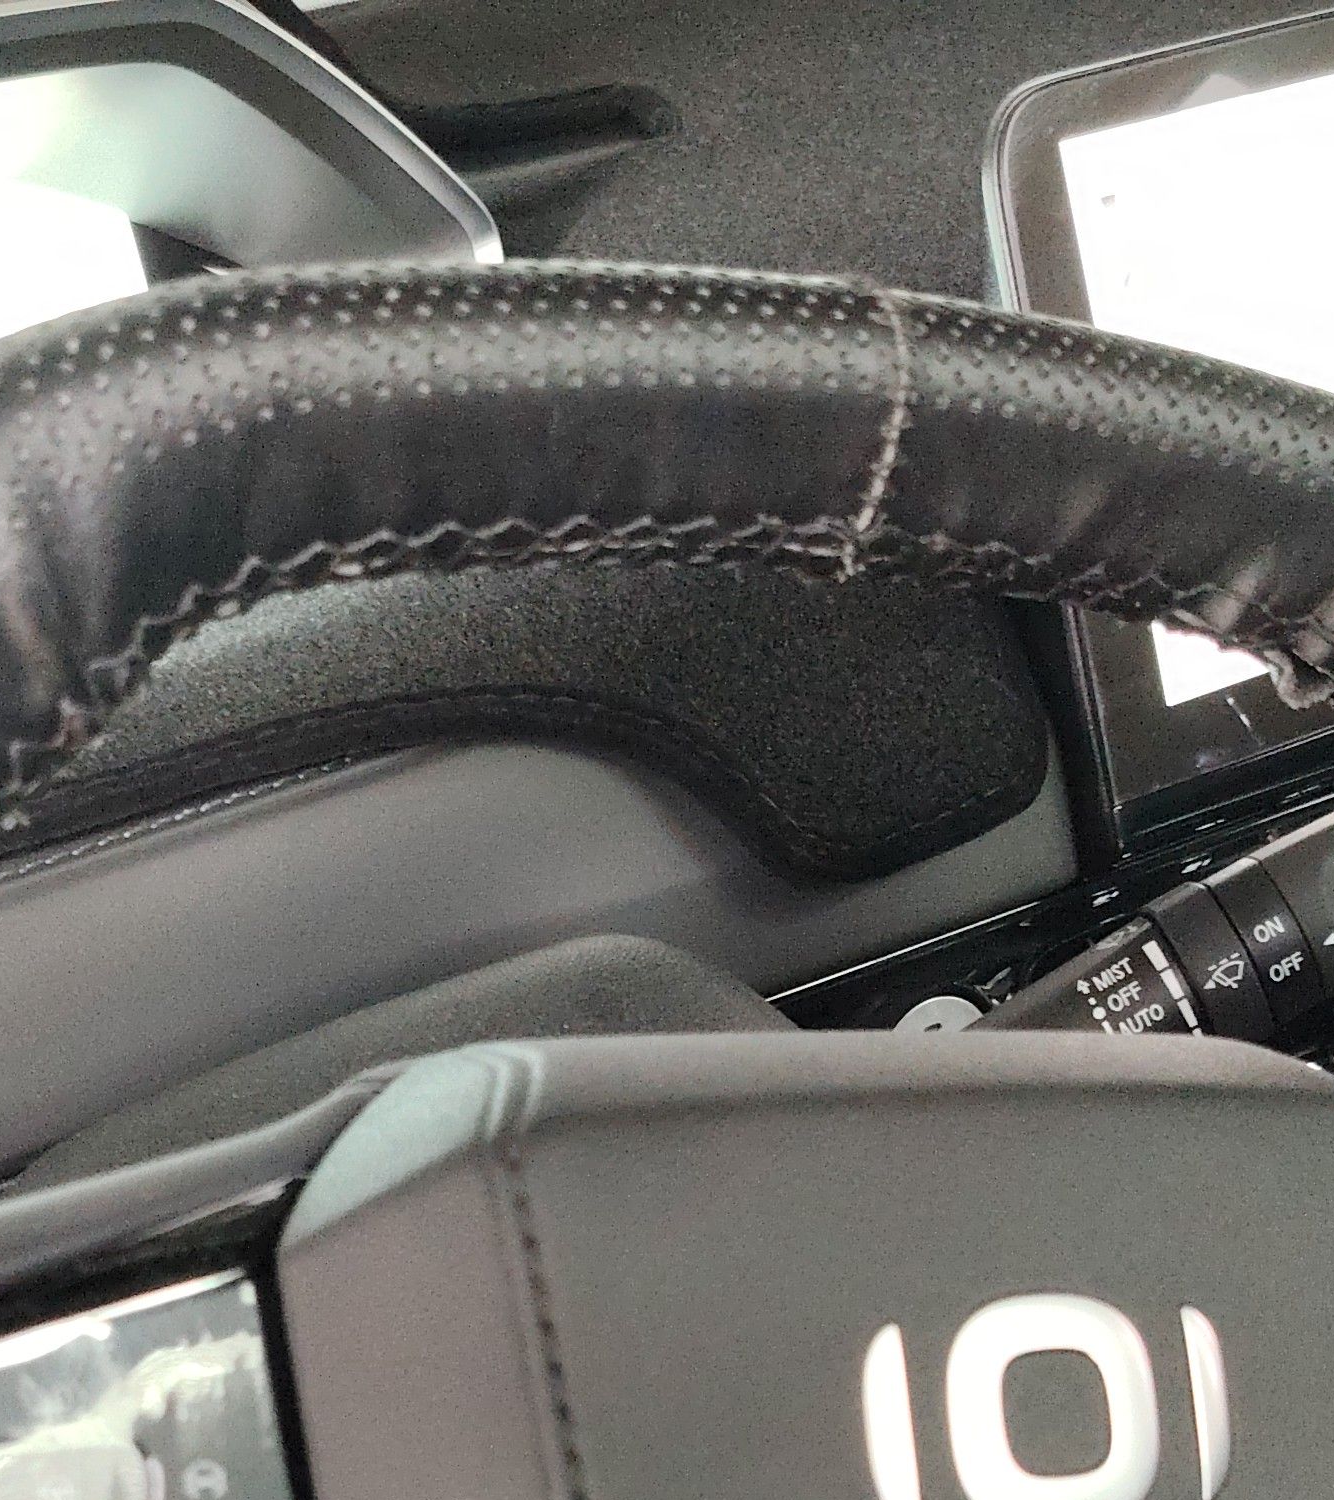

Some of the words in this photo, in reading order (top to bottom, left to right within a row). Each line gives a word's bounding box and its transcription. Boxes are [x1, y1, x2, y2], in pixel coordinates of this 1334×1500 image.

[1253, 915, 1286, 944] ON
[1091, 956, 1134, 992] MIST
[1269, 950, 1305, 983] OFF
[1106, 980, 1142, 1012] OFF
[1118, 1003, 1166, 1035] AUTO
